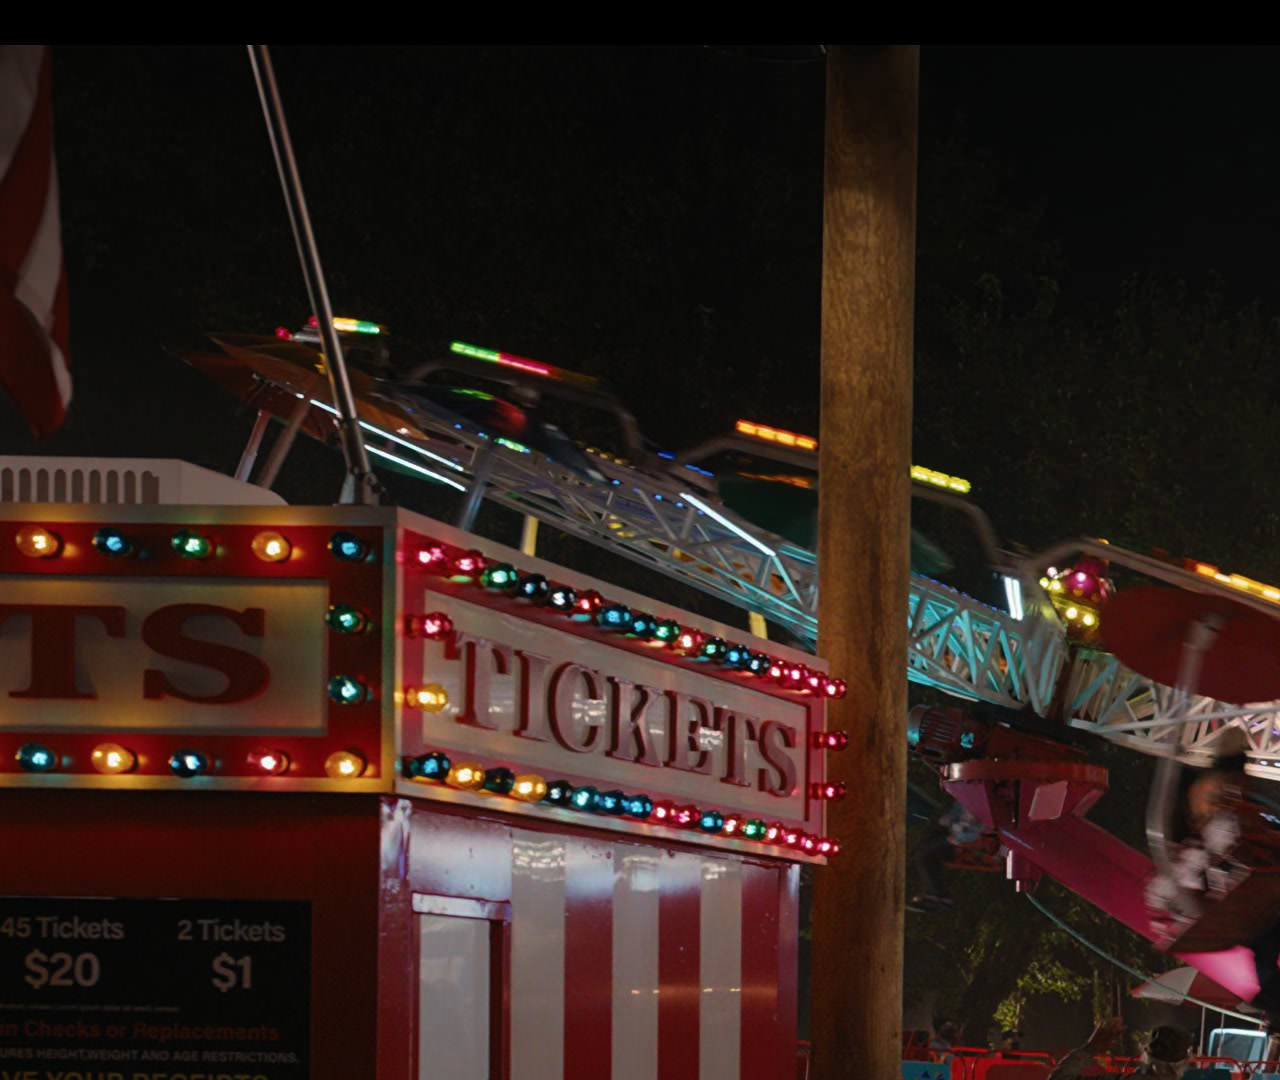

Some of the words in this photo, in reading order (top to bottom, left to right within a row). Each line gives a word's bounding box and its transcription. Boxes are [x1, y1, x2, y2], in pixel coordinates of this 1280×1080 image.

[445, 630, 798, 799] TICKETS
[35, 915, 125, 941] Tickets
[177, 919, 193, 942] 2
[197, 918, 286, 943] Tickets
[24, 948, 101, 990] $20
[210, 952, 252, 992] $1
[24, 1020, 100, 1038] Checks
[105, 1023, 126, 1039] or
[133, 1023, 280, 1043] Replacements
[140, 1050, 168, 1062] AND
[172, 1051, 200, 1062] AGE
